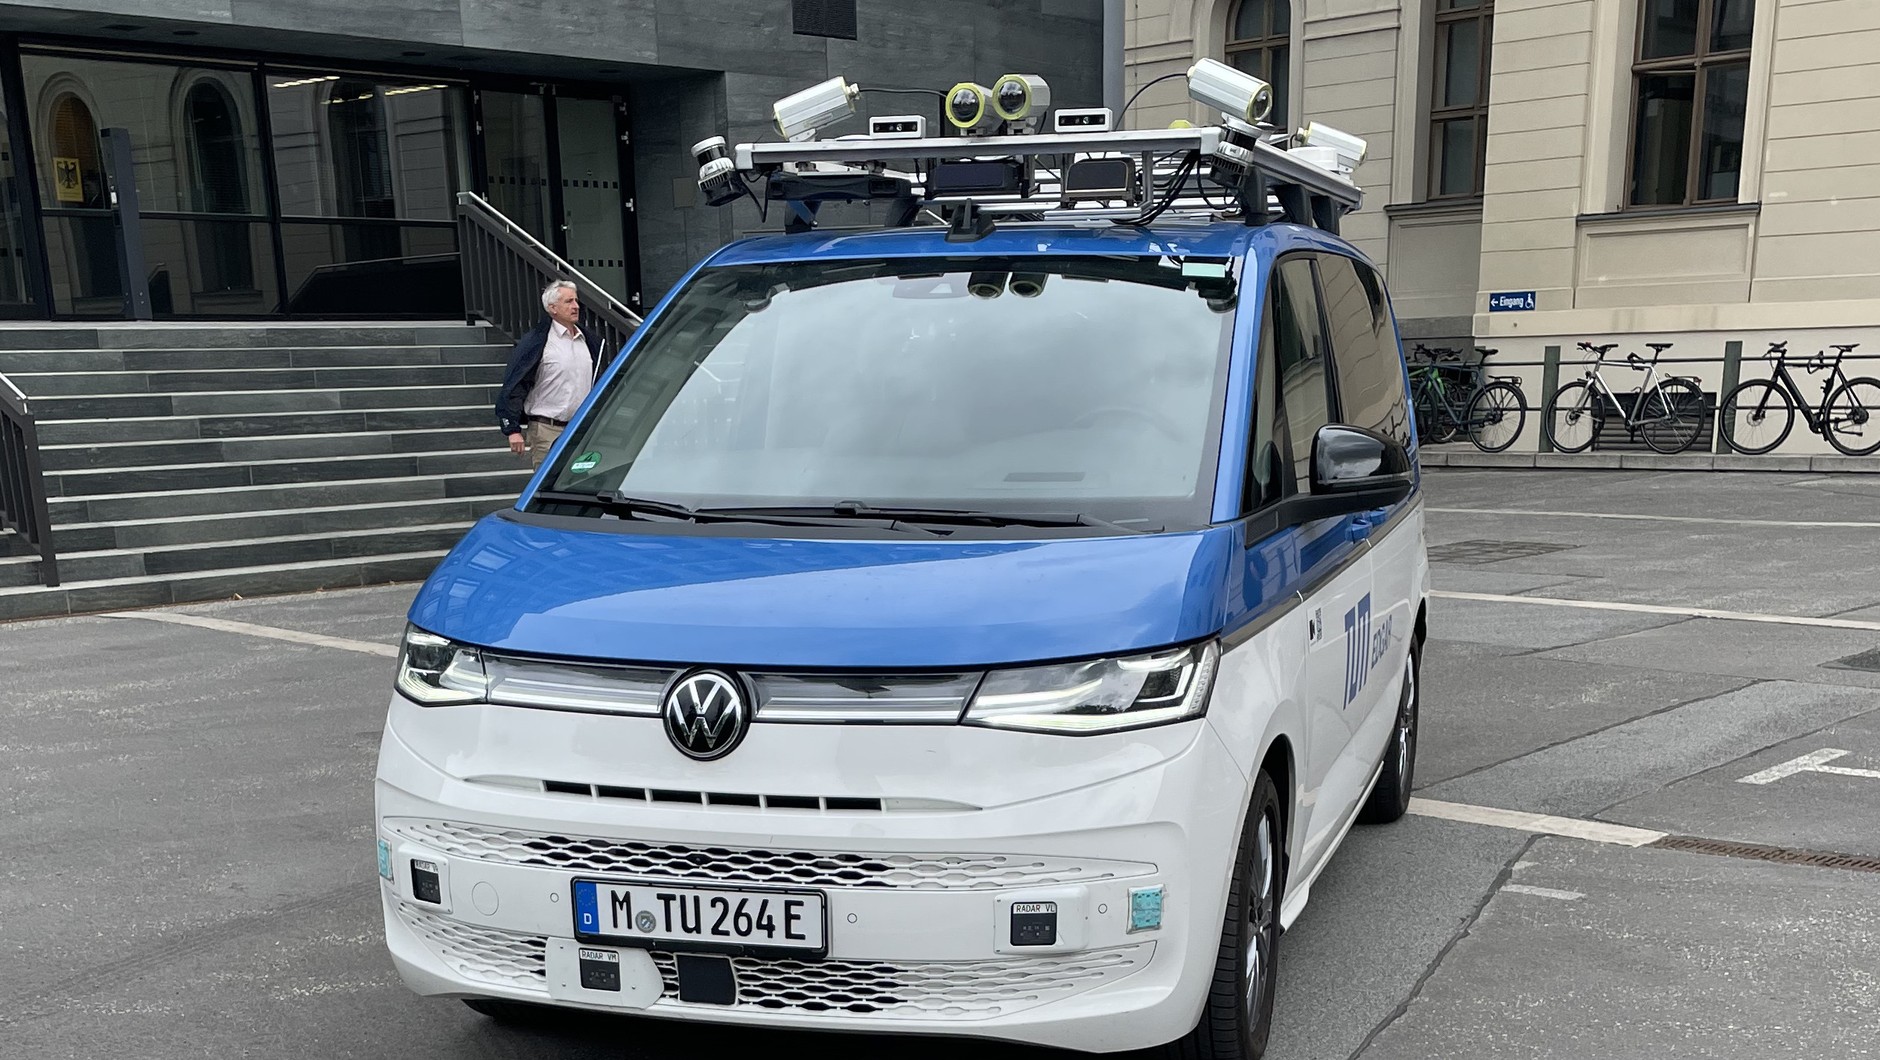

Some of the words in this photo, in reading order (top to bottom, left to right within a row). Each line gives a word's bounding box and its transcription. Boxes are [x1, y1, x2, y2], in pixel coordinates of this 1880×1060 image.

[1500, 296, 1524, 308] Eingang
[611, 890, 633, 929] M
[1016, 904, 1041, 912] RADAR
[1045, 904, 1055, 912] VL
[583, 913, 592, 924] D
[581, 950, 603, 960] RADAR
[607, 953, 617, 961] VM
